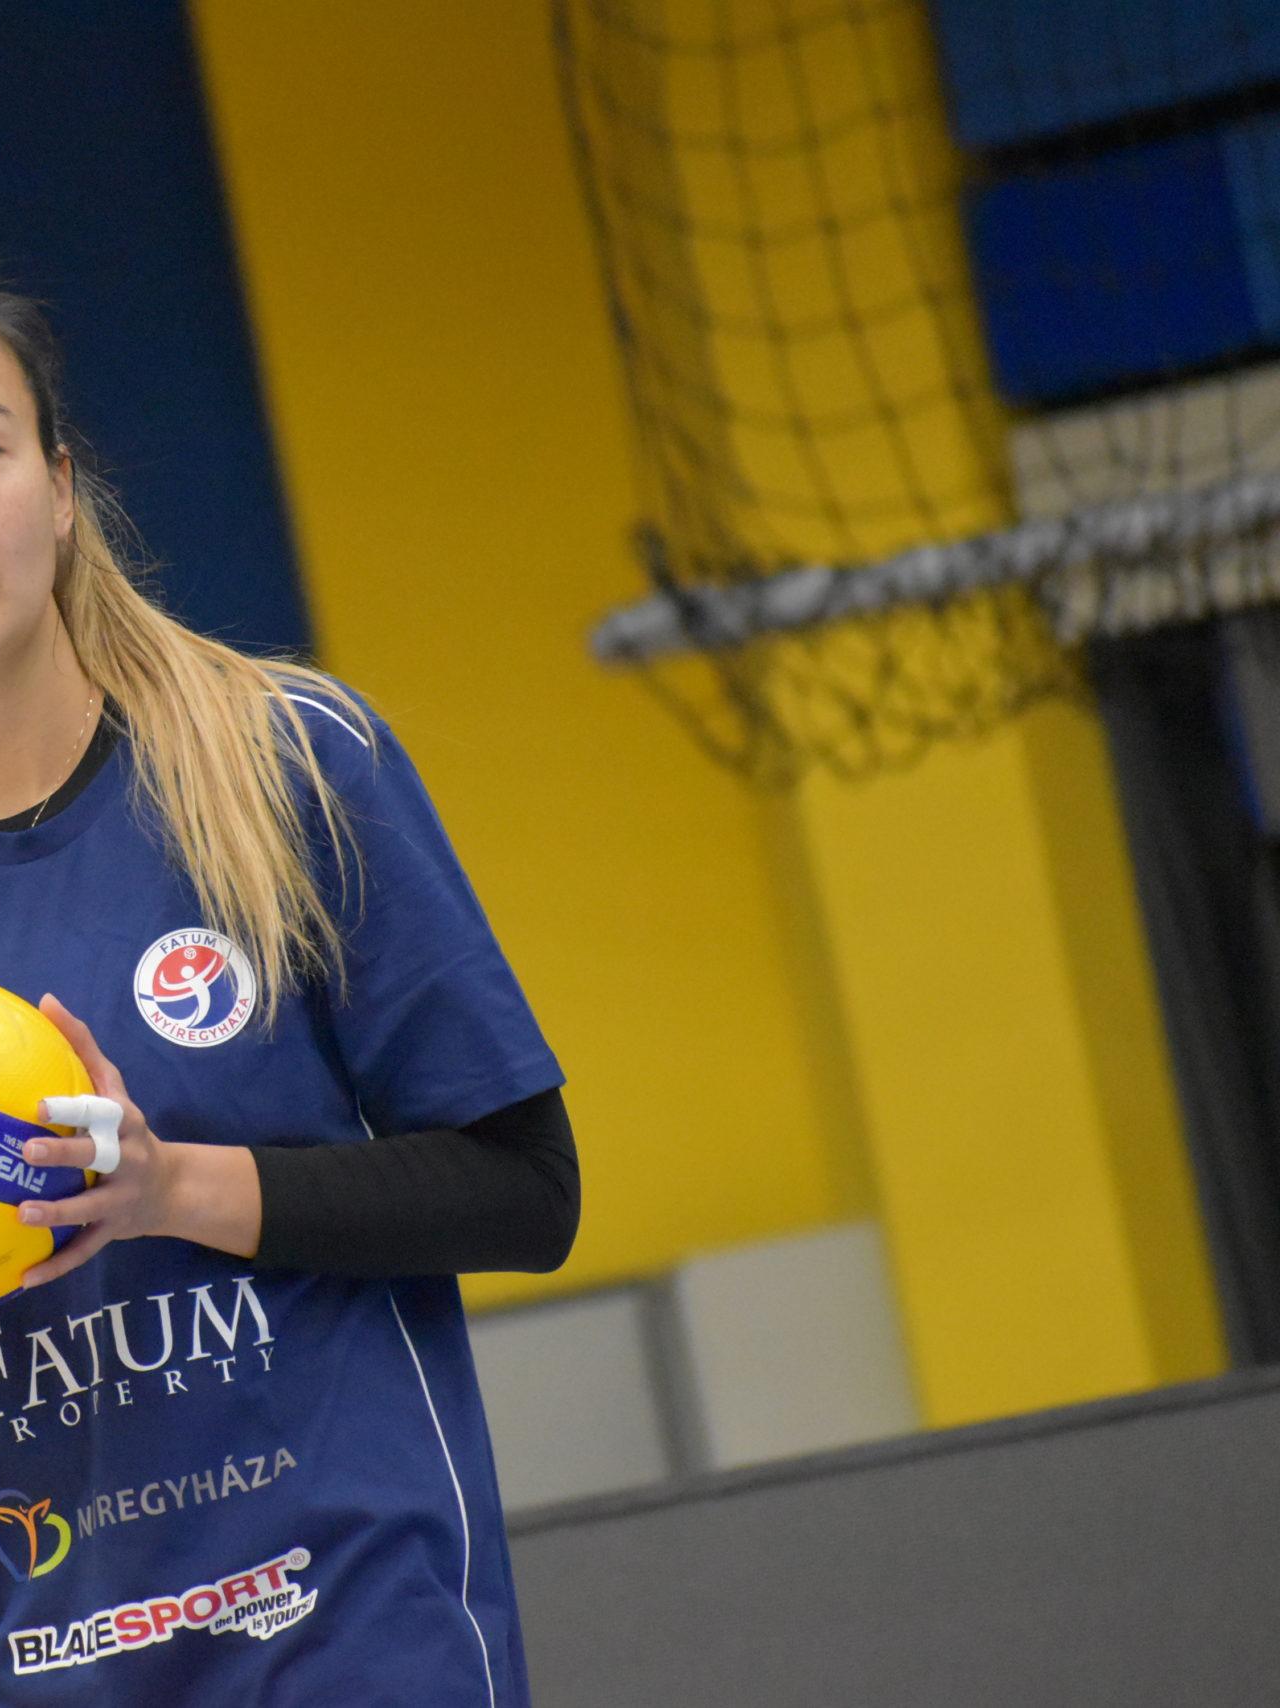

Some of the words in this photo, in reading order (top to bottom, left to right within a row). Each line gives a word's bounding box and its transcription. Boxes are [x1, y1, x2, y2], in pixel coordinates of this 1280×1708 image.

[160, 934, 217, 954] FATUM
[76, 1447, 298, 1539] NREGYHÁZA
[234, 1590, 296, 1625] power
[252, 1617, 263, 1630] is
